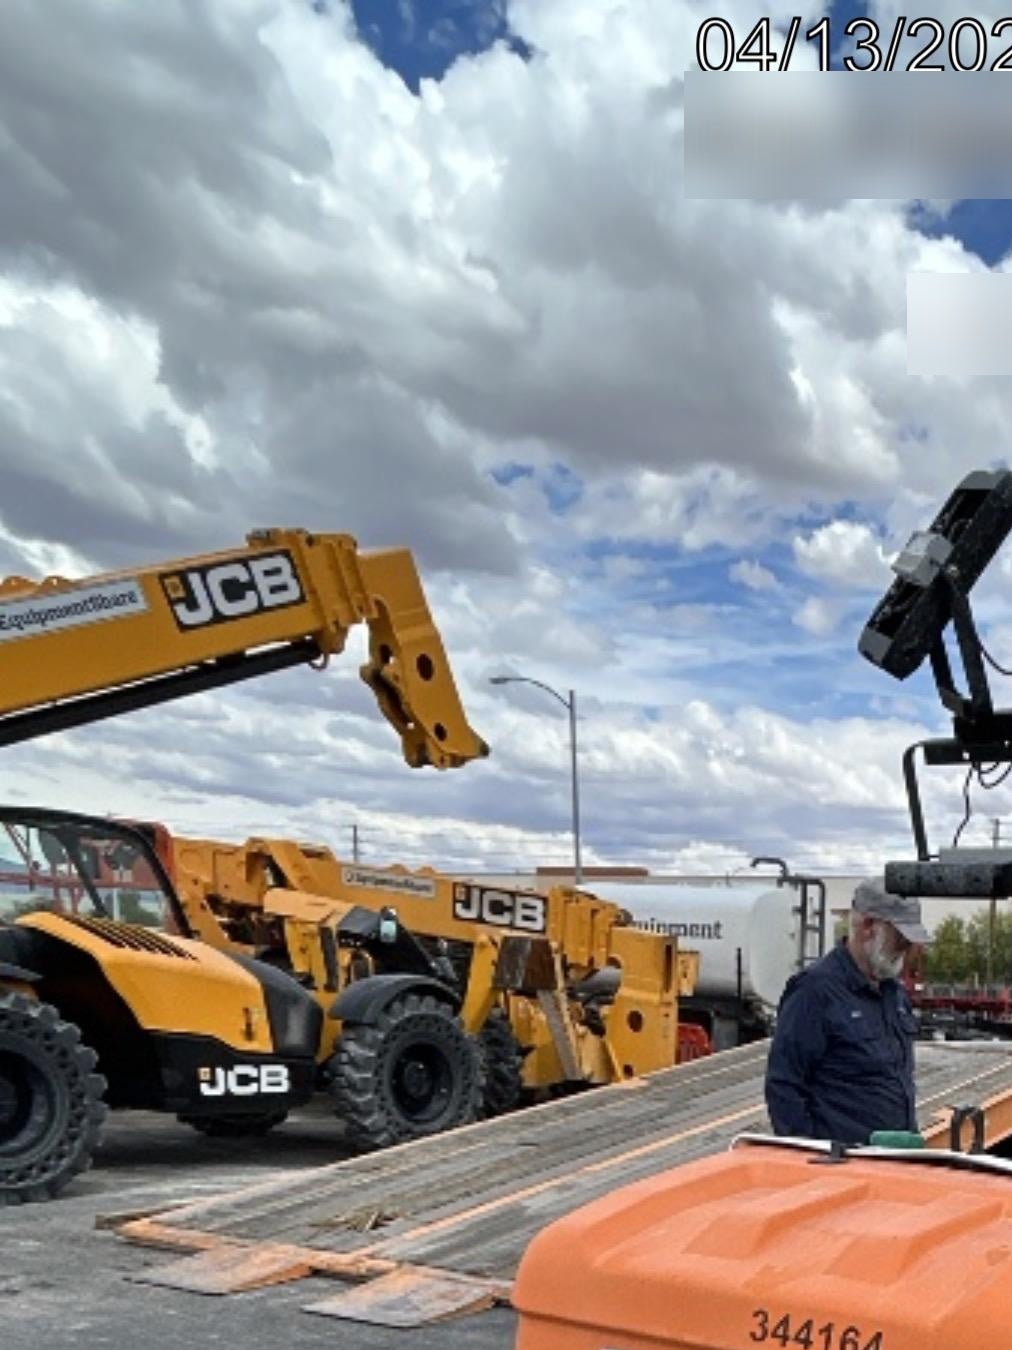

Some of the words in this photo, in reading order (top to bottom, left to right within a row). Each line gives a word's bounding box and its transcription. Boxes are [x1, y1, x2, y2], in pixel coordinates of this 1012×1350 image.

[173, 553, 300, 627] JCB
[454, 885, 546, 932] JCB
[631, 917, 723, 940] uipment
[200, 1064, 290, 1096] JCB
